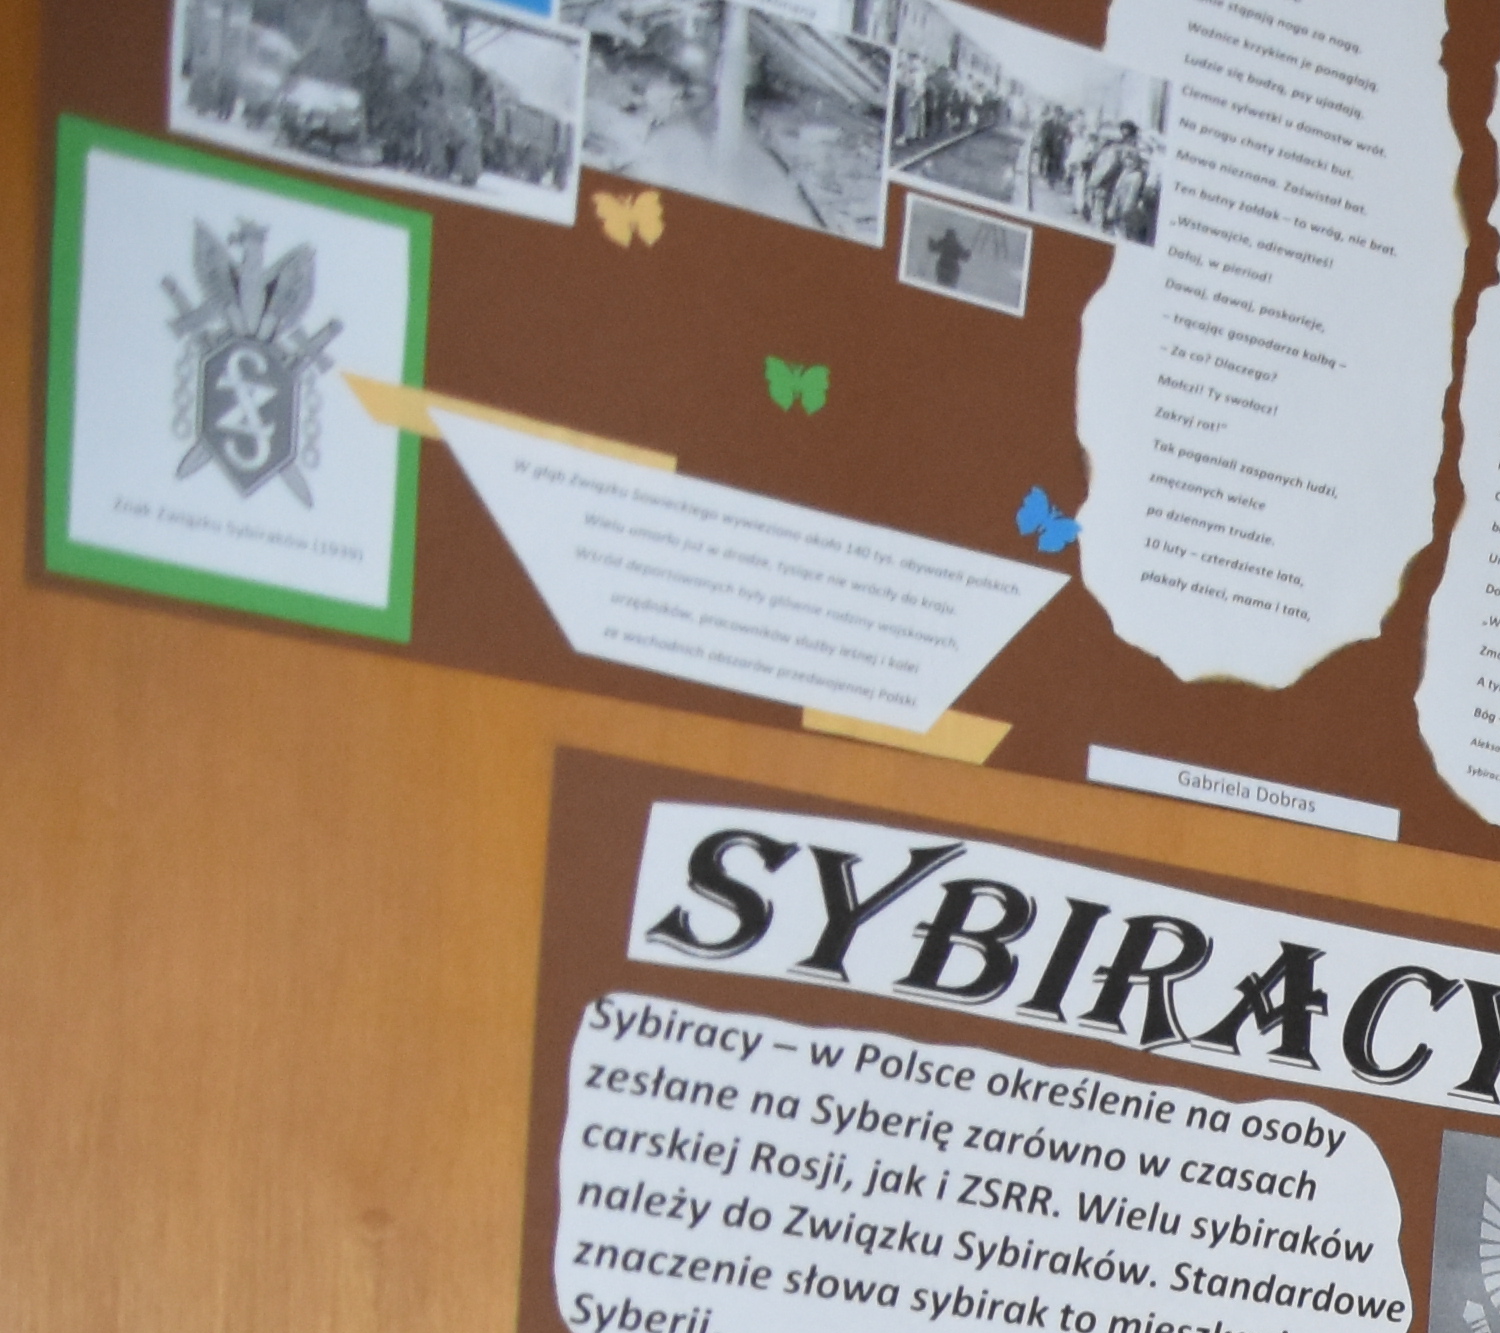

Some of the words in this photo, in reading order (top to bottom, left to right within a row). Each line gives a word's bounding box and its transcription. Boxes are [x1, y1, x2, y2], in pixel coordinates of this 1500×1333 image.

[1473, 707, 1497, 724] Bóg
[1178, 770, 1250, 799] Gabriela
[1256, 786, 1316, 813] Dobras
[585, 1064, 739, 1110] zesłane
[750, 1091, 801, 1120] na
[810, 1093, 954, 1153] Syberię
[963, 1125, 1126, 1172] zarówno
[1139, 1152, 1171, 1178] w
[1179, 1159, 1317, 1202] czasach
[588, 998, 763, 1062] Sybiracy
[810, 1042, 845, 1068] w
[854, 1043, 976, 1091] Polsce
[986, 1067, 1176, 1124] określenie
[1185, 1105, 1231, 1133] na
[1241, 1115, 1347, 1158] osoby
[578, 1181, 712, 1230] należy
[722, 1196, 772, 1232] do
[782, 1205, 944, 1257] Związku
[953, 1230, 1157, 1288] Sybiraków.
[1169, 1262, 1407, 1324] Standardowe
[582, 1124, 741, 1176] carskiej
[750, 1142, 853, 1193] Rosji,
[862, 1159, 927, 1198] jak
[936, 1169, 950, 1201] i
[956, 1173, 1060, 1218] ZSRR.
[1078, 1191, 1181, 1236] Wielu
[1190, 1213, 1374, 1264] sybiraków
[573, 1241, 773, 1290] znaczenie
[784, 1264, 900, 1308] słowa
[910, 1285, 1049, 1328] sybirak
[1060, 1304, 1097, 1333] to
